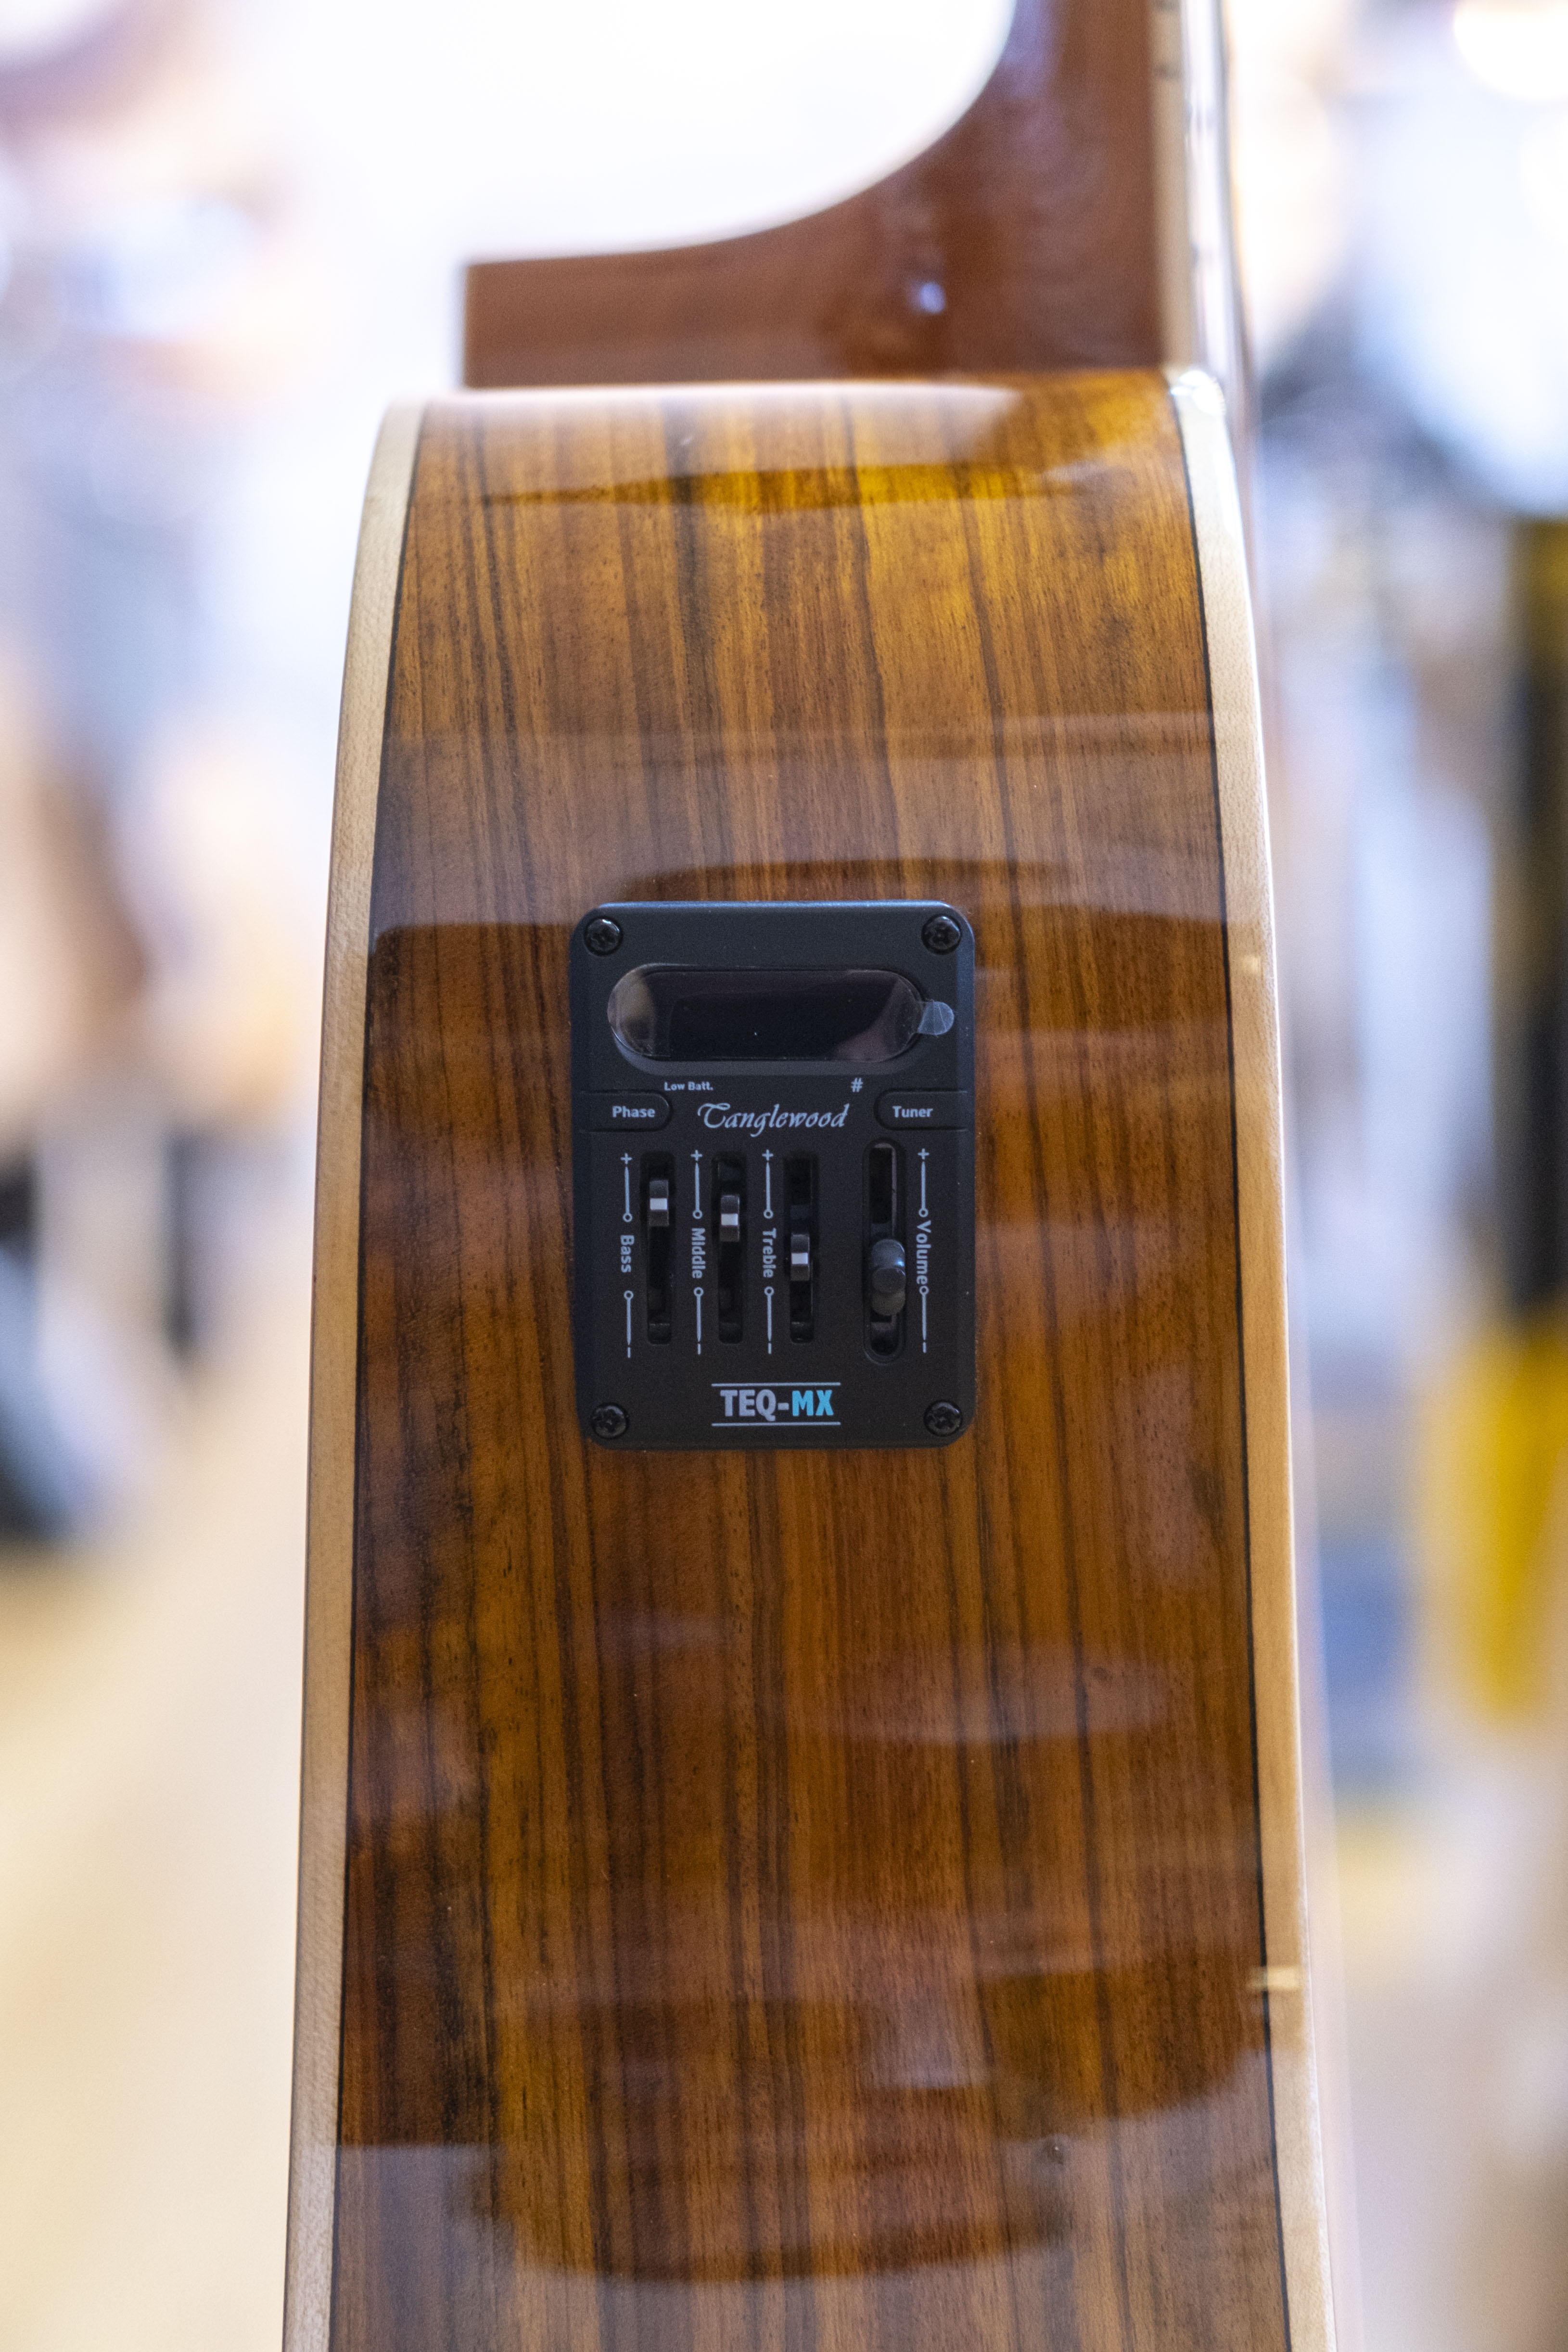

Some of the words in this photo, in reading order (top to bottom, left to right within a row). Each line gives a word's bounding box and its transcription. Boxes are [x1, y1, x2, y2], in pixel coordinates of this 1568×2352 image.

[664, 1082, 685, 1091] Low
[688, 1081, 714, 1091] Batt.
[851, 1078, 864, 1092] #
[612, 1105, 656, 1118] Phase
[697, 1103, 850, 1138] Tanglewood
[892, 1105, 933, 1118] Tuner
[620, 1235, 635, 1273] Bass
[691, 1227, 706, 1279] Middle
[762, 1227, 777, 1278] Treble
[916, 1220, 931, 1285] Volume
[720, 1389, 834, 1421] TEQ-MX
